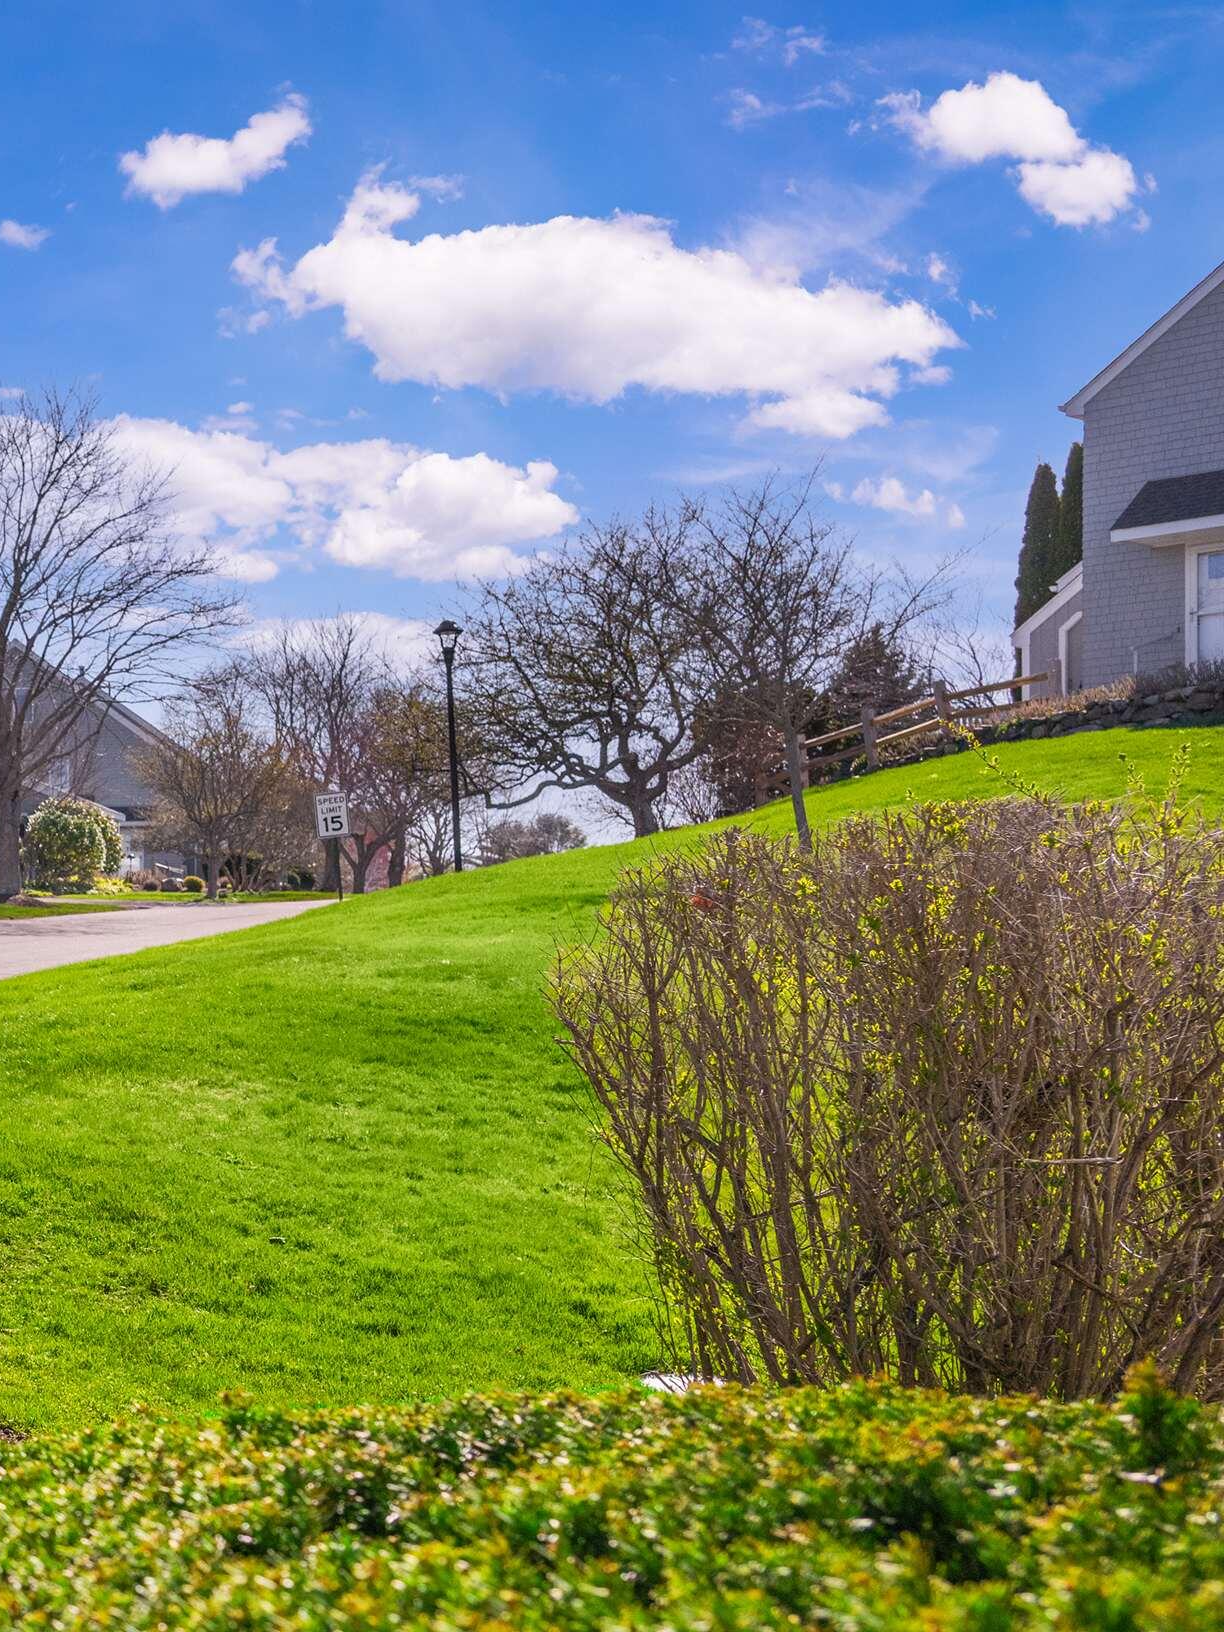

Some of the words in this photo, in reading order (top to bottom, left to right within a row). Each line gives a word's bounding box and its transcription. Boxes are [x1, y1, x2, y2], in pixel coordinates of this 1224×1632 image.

[318, 796, 344, 806] SPEED
[321, 805, 343, 815] LIMIT
[323, 815, 343, 832] 15
